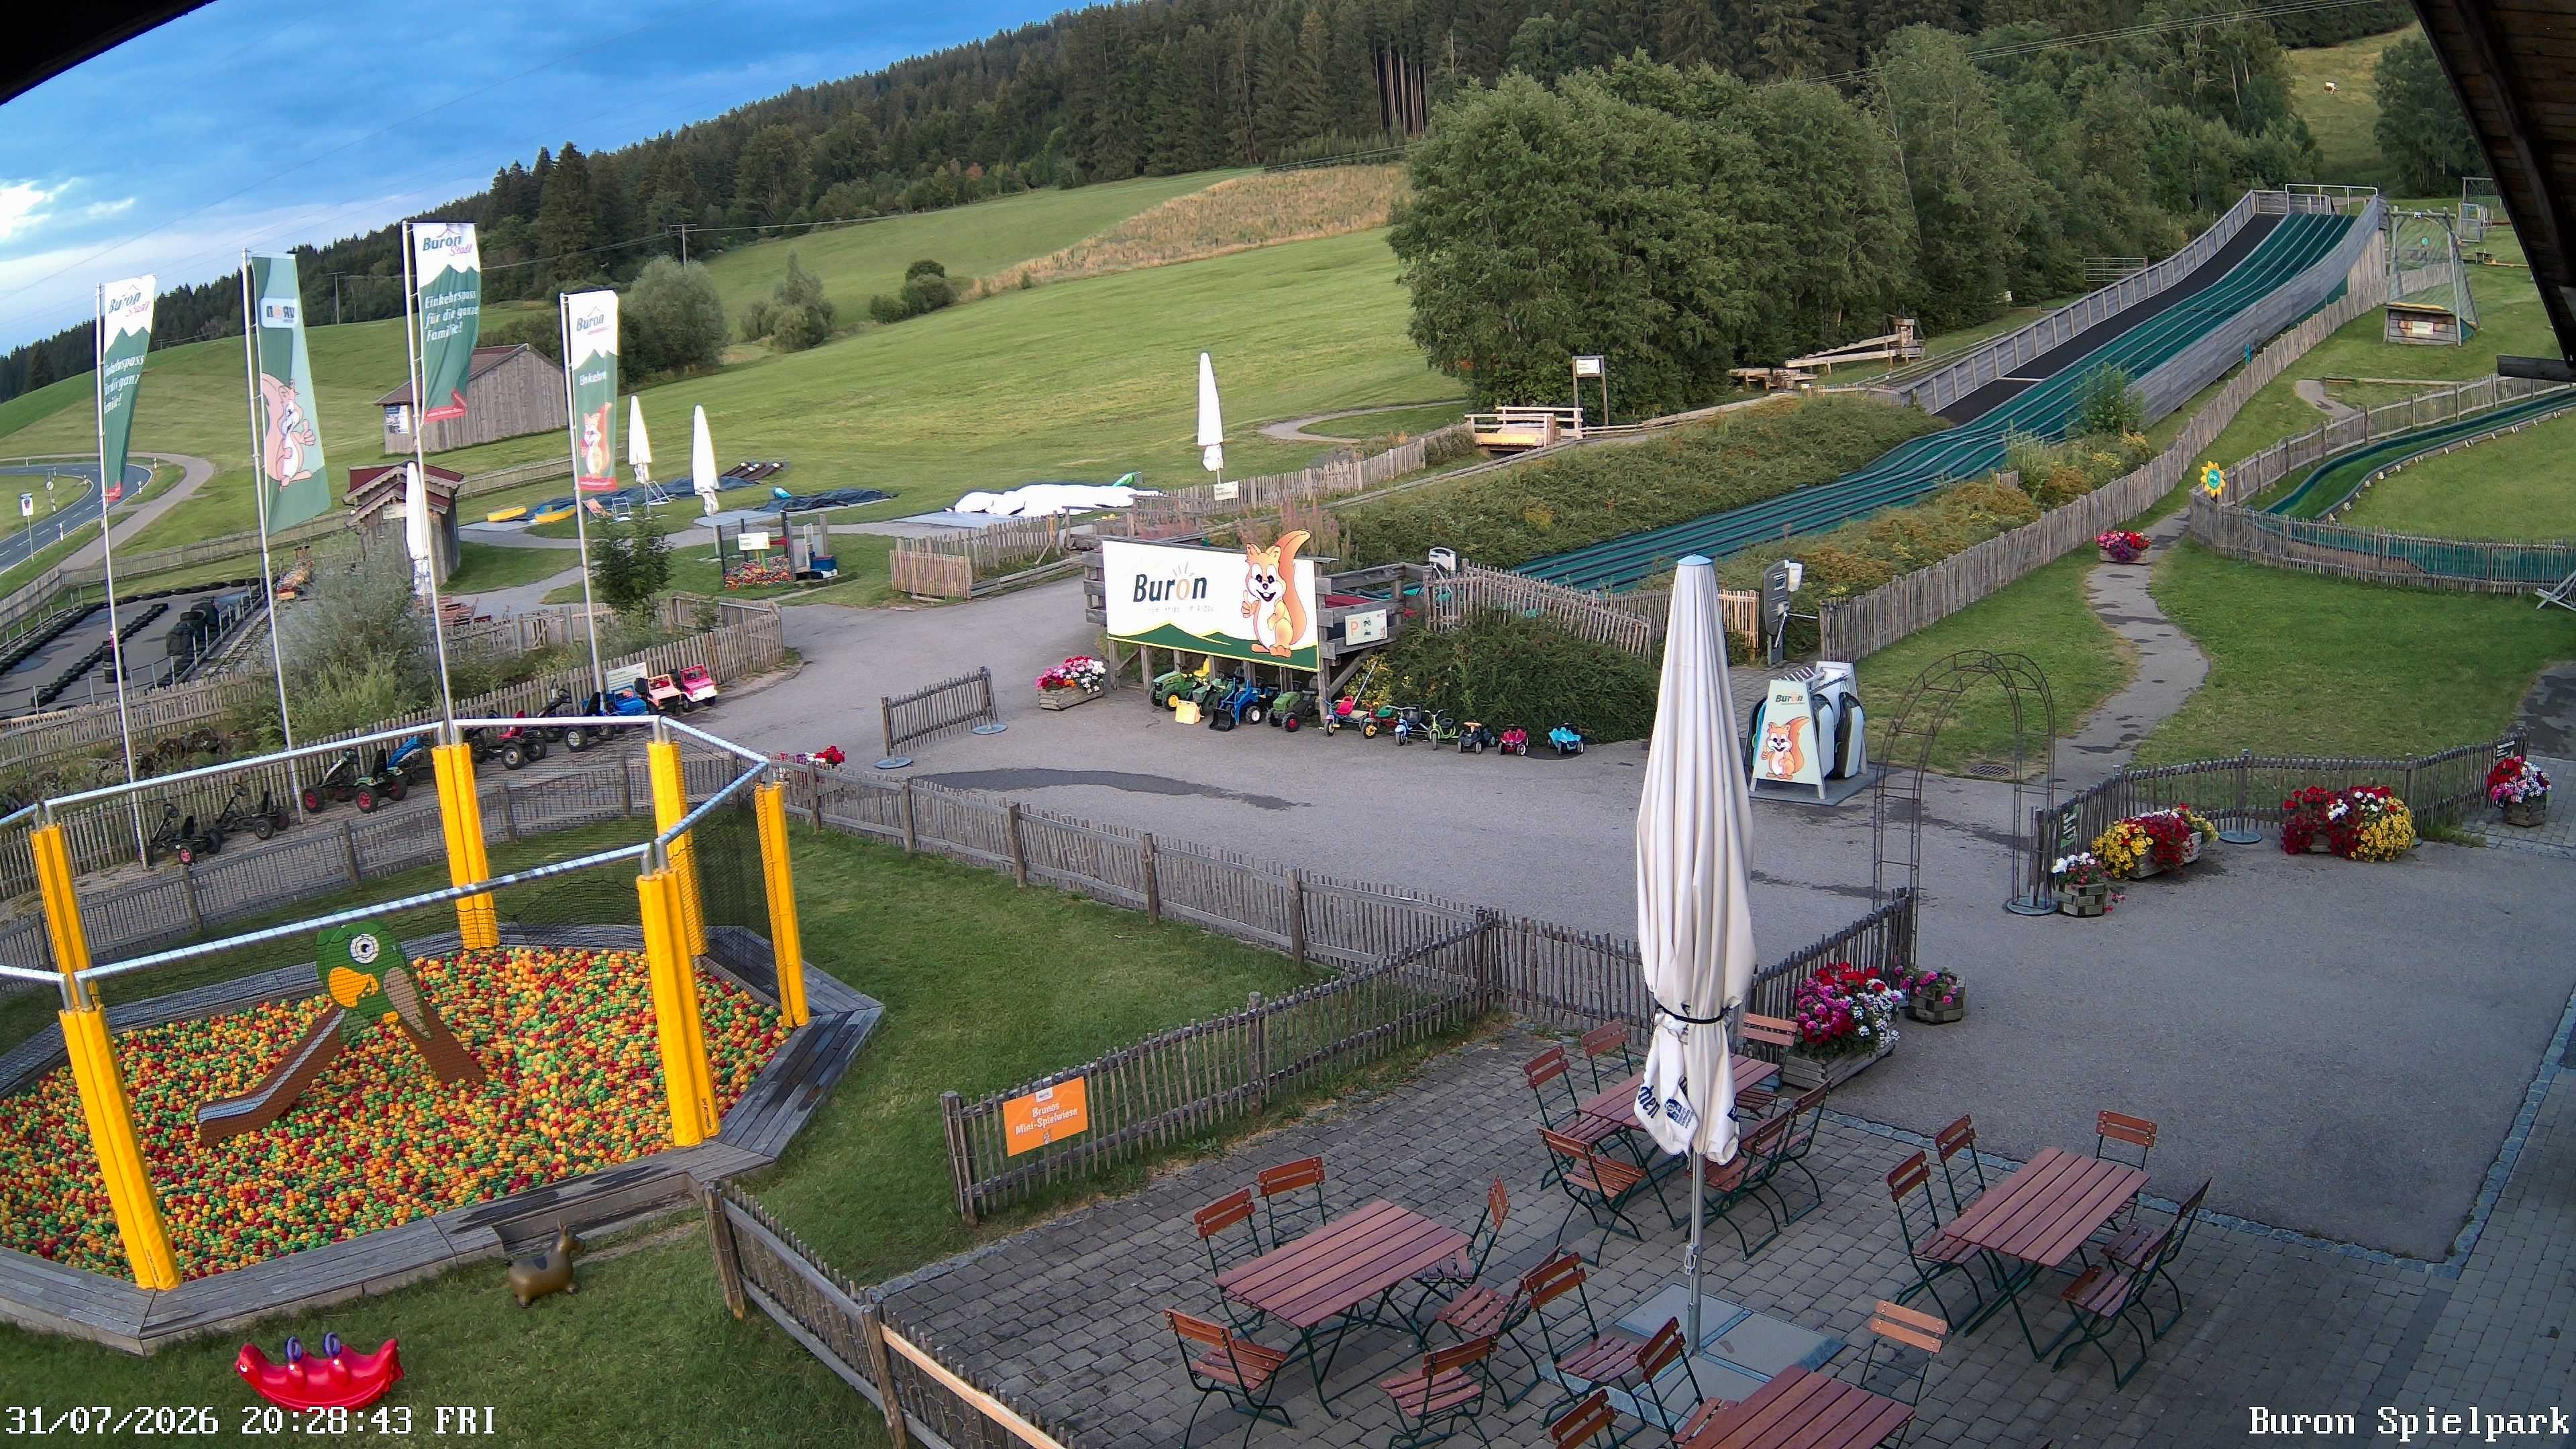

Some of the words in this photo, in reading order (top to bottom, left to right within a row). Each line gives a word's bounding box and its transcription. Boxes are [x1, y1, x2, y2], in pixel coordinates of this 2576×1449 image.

[422, 235, 462, 251] Buron
[425, 290, 476, 309] Einkehrspass
[425, 312, 441, 329] für
[443, 309, 456, 321] die
[576, 313, 604, 331] Buron
[426, 320, 463, 342] Familie!
[1133, 574, 1208, 602] Buron
[1350, 621, 1358, 637] P
[1775, 694, 1803, 702] Buron
[1032, 1102, 1061, 1118] Brunos
[1016, 1108, 1078, 1135] Mini-Spielwiese
